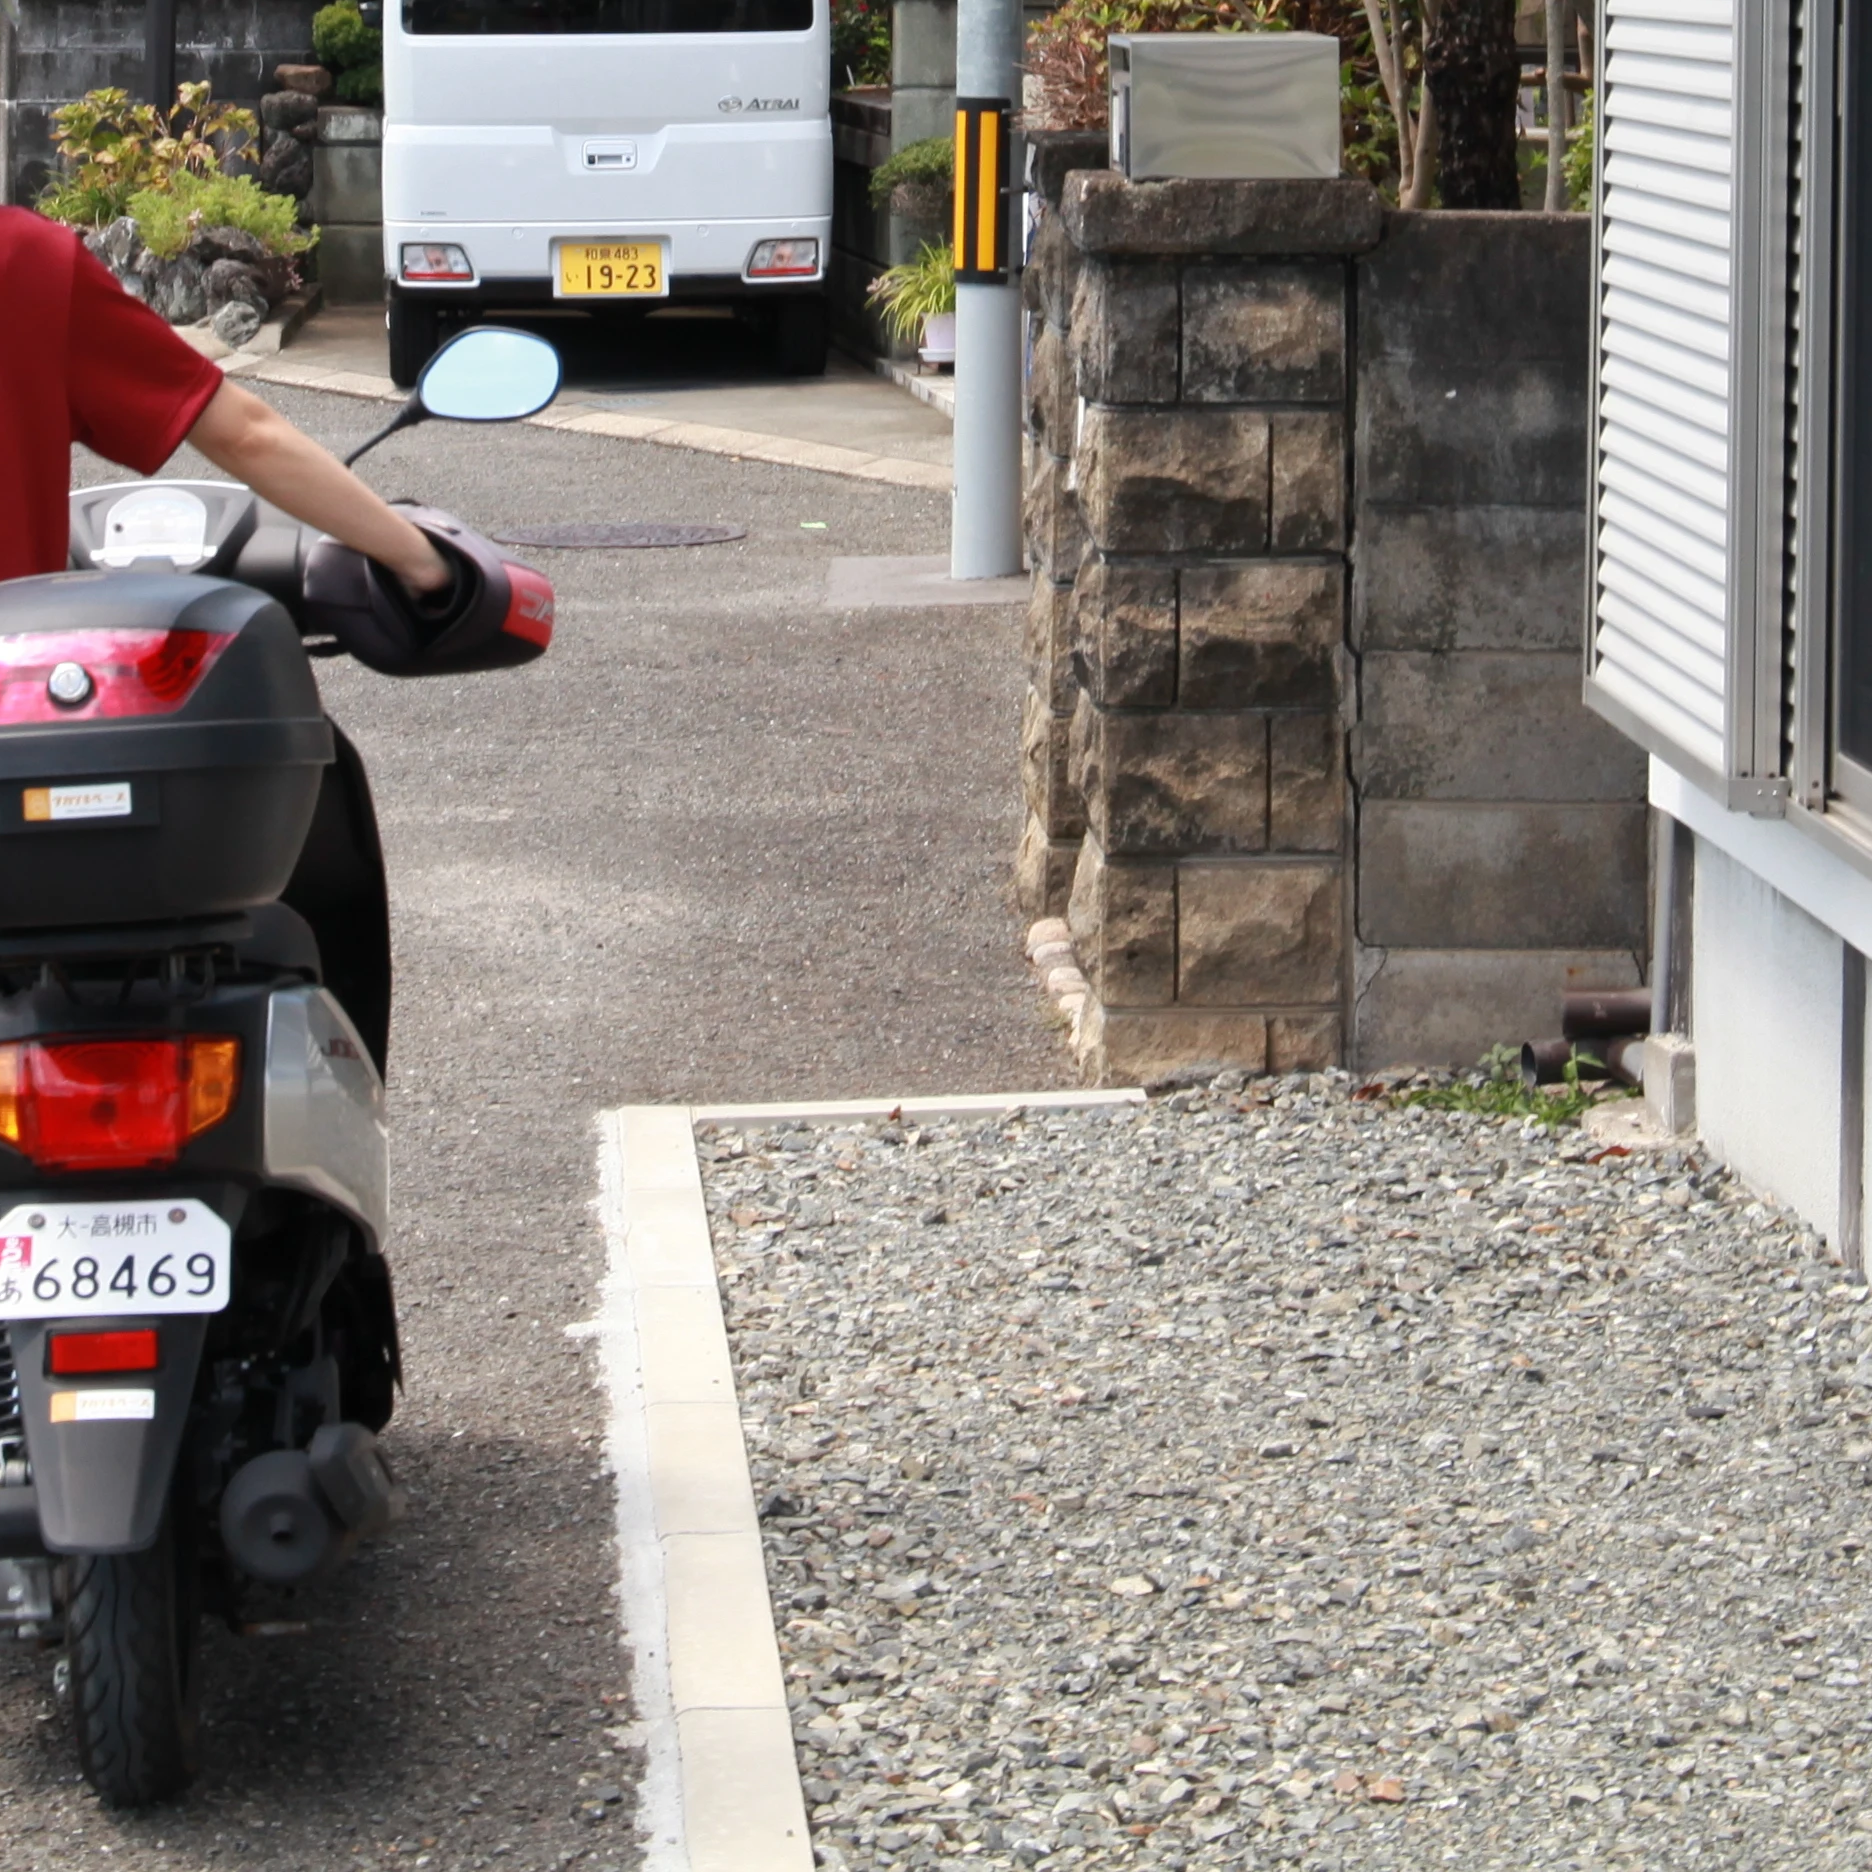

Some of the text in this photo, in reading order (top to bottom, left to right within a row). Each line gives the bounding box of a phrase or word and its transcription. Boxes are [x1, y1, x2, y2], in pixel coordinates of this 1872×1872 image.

[743, 97, 800, 111] ATRAI
[614, 247, 639, 261] 483
[587, 264, 656, 290] 19-23
[32, 1252, 216, 1301] 68469
